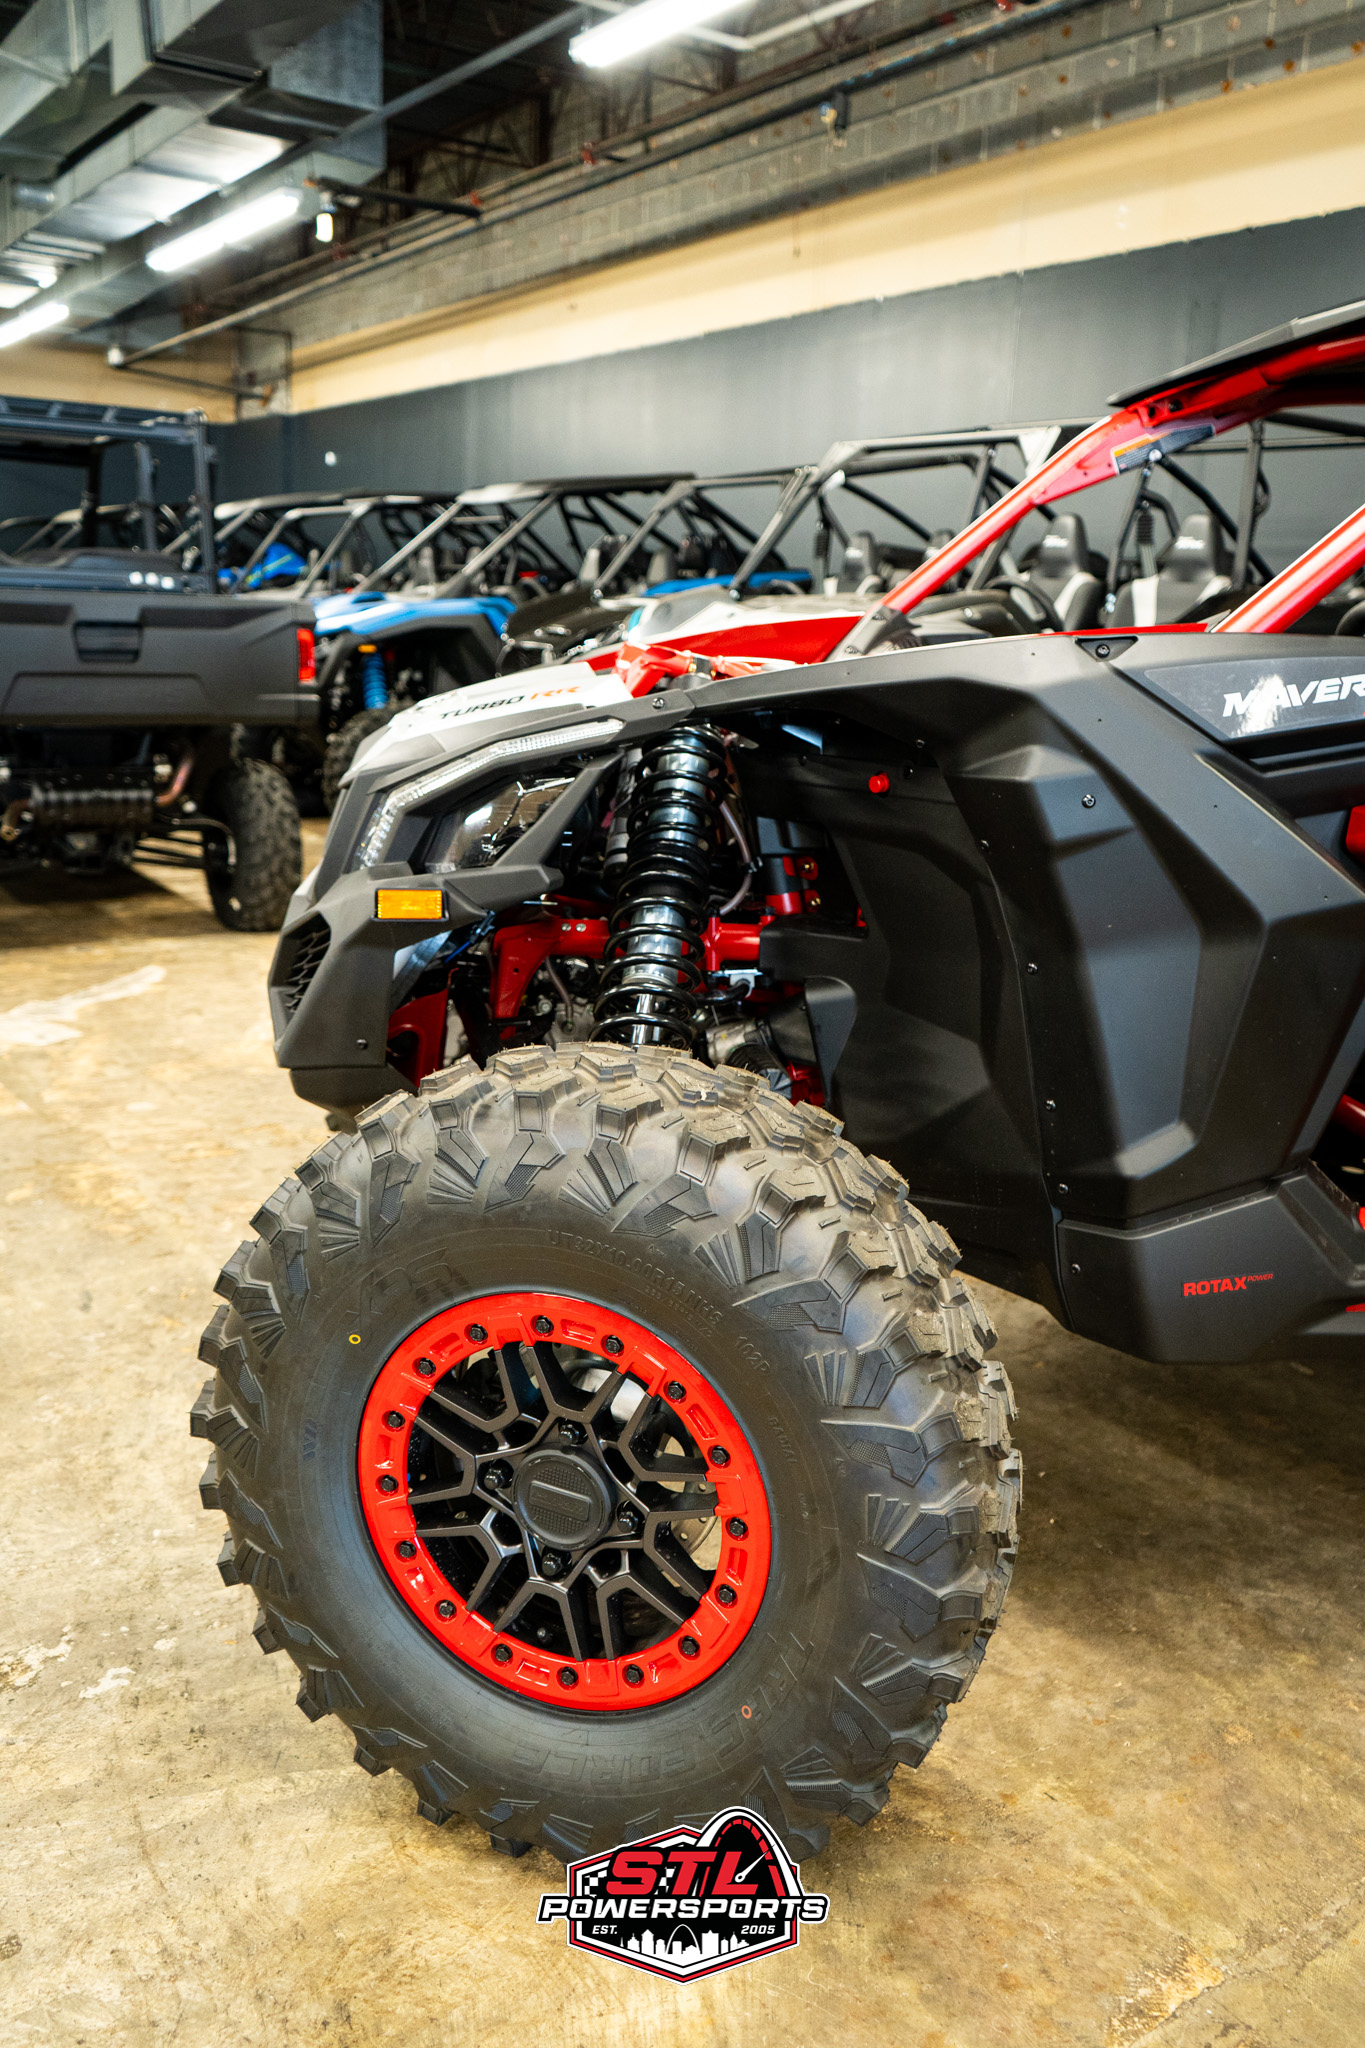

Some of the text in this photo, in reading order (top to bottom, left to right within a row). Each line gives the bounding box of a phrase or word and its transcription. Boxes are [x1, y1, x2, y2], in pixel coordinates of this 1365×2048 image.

[440, 696, 525, 720] TURBO
[530, 686, 580, 700] RR
[1183, 1273, 1274, 1297] ROTAX POWER
[734, 1335, 771, 1376] 102P
